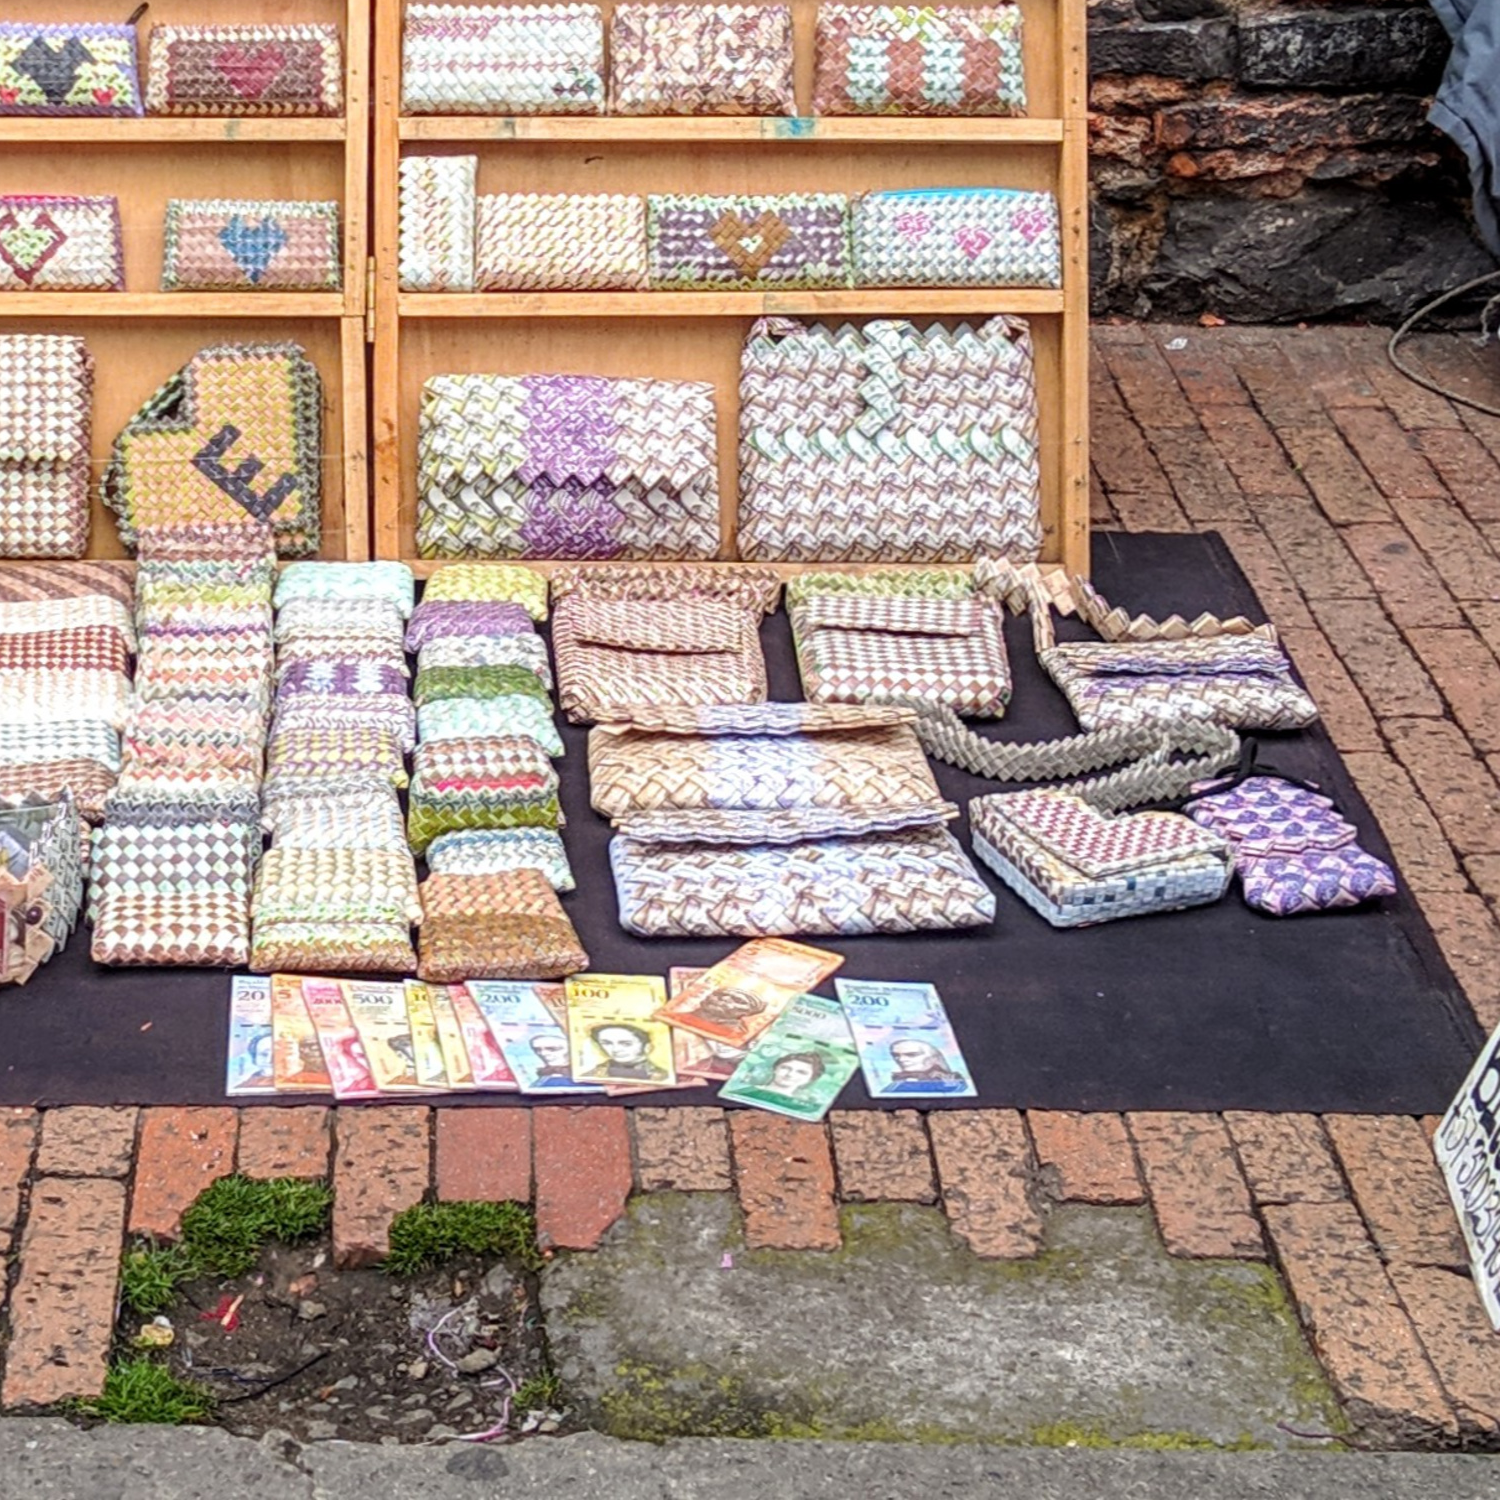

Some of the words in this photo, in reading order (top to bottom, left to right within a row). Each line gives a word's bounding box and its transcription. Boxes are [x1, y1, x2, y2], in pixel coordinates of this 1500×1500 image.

[237, 990, 266, 1002] 20
[352, 993, 393, 1006] 500
[482, 993, 521, 1004] 200
[574, 988, 610, 1000] 100
[849, 995, 889, 1007] 200
